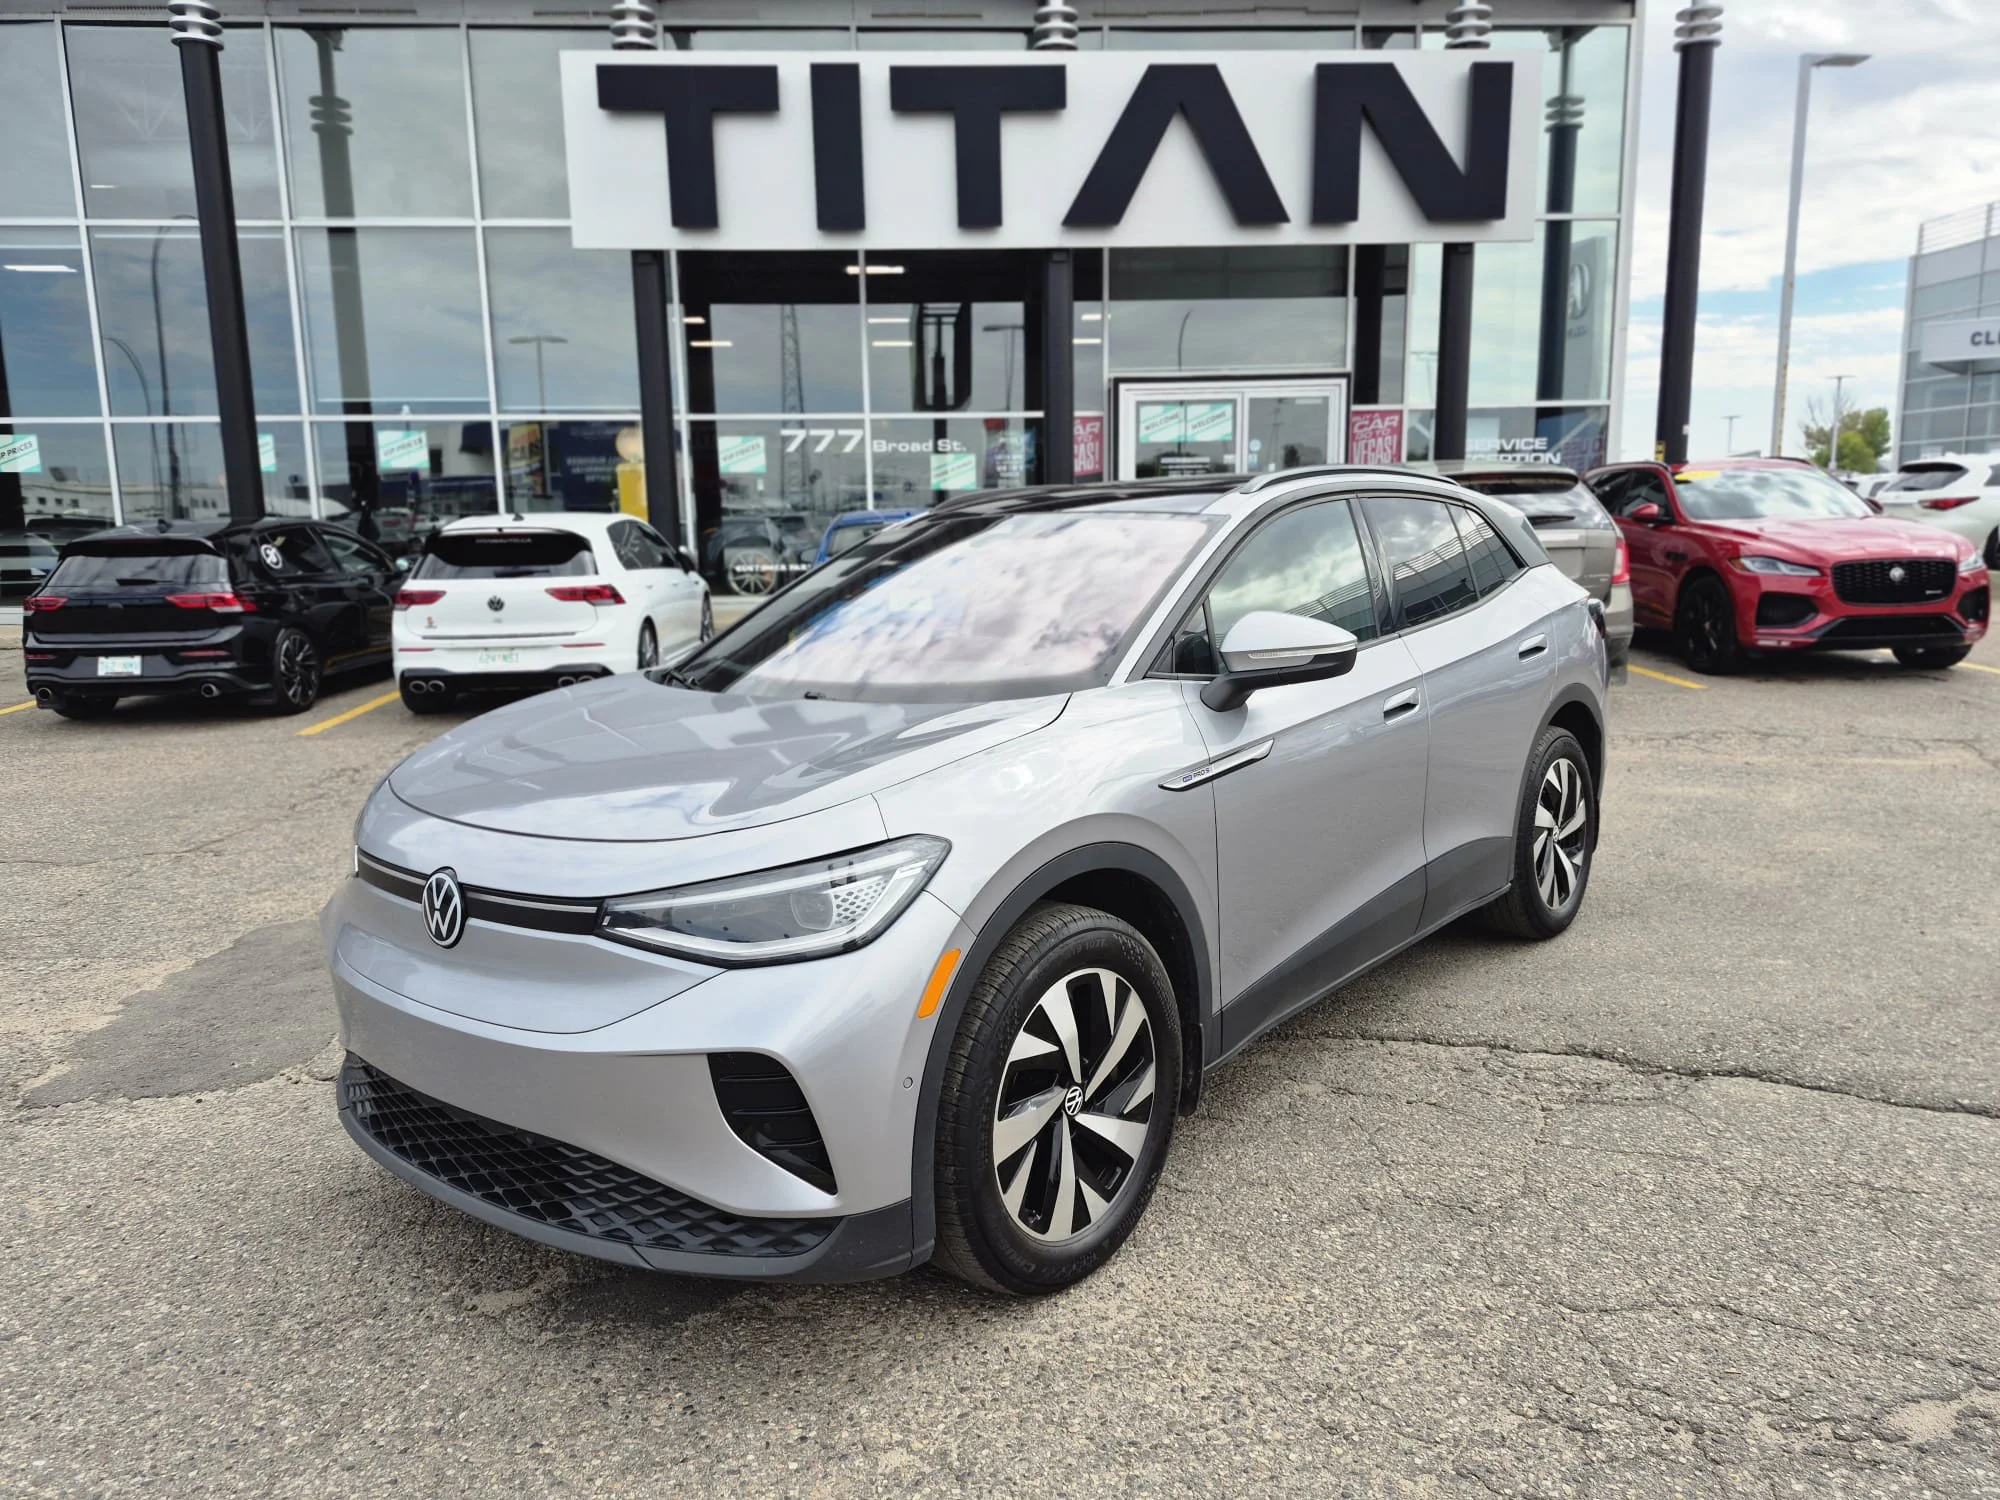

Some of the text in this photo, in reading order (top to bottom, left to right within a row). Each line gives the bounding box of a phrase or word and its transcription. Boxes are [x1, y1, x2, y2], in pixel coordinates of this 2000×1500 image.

[595, 61, 1517, 232] TITAN
[1074, 421, 1101, 436] AR
[1354, 415, 1399, 432] CAR
[780, 429, 864, 453] 777
[873, 439, 966, 453] Broad St.
